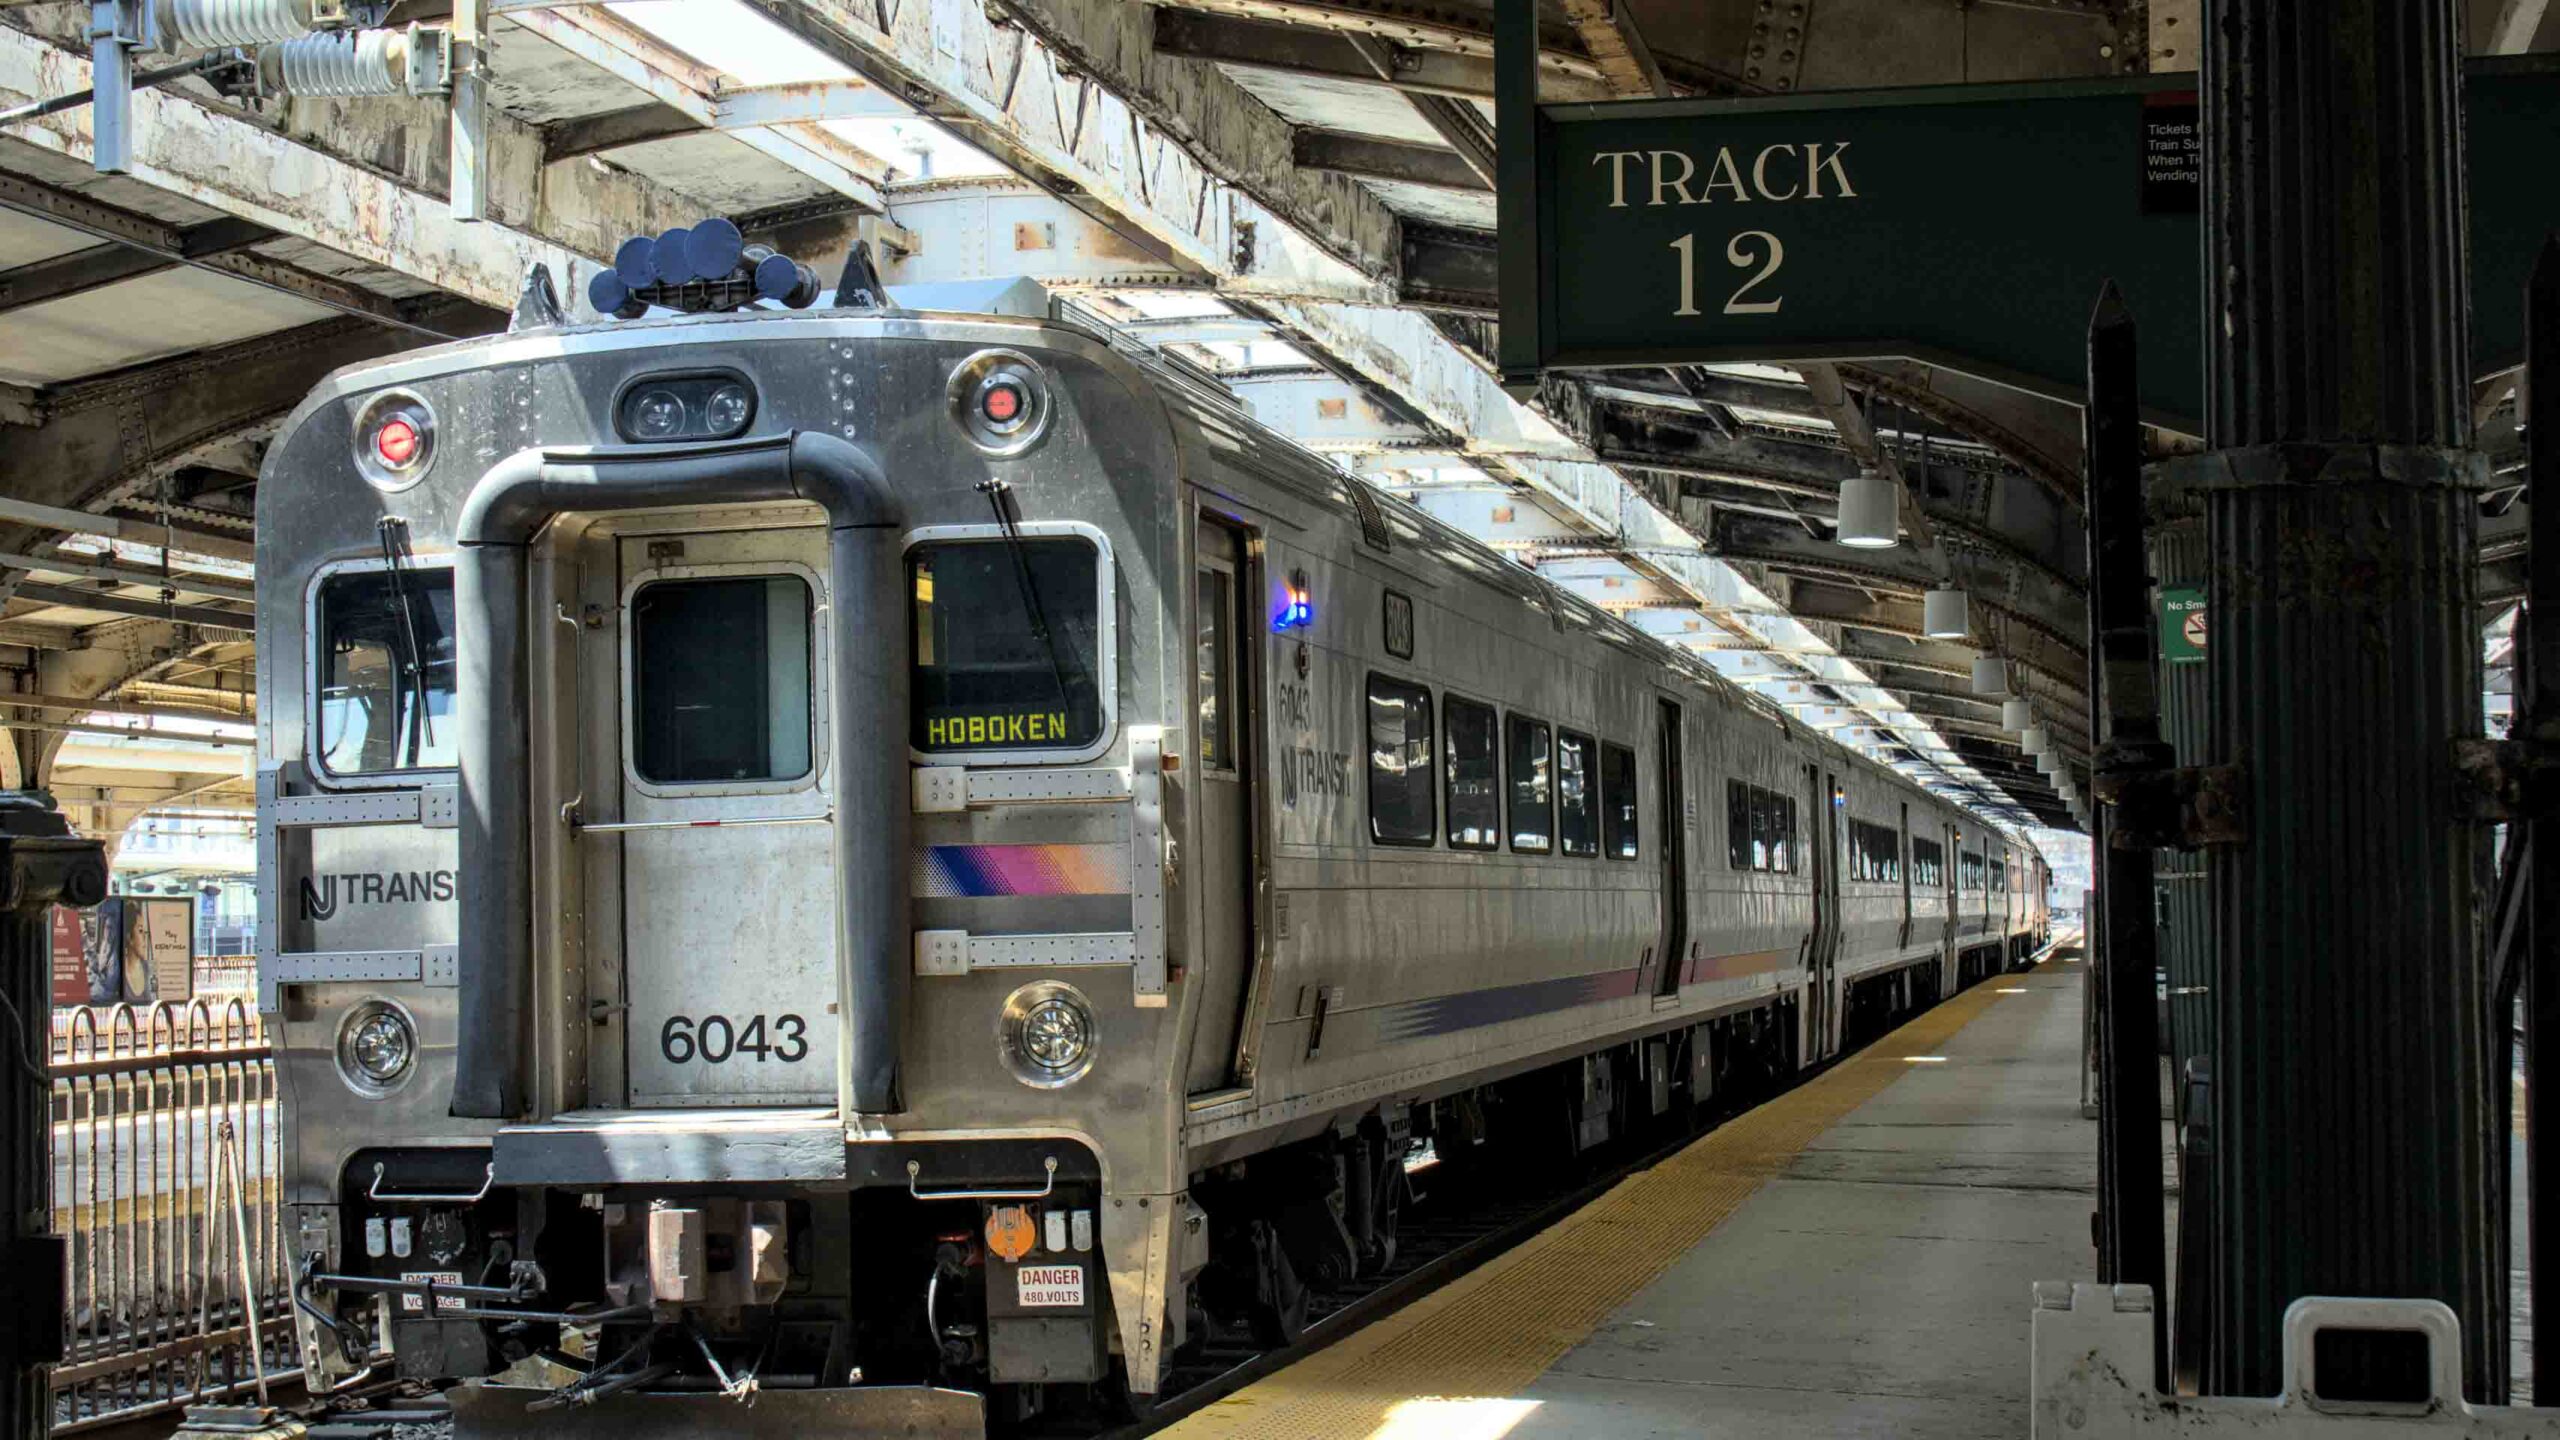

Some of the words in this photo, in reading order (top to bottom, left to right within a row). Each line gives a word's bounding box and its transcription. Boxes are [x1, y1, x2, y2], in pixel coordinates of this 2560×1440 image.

[2147, 123, 2192, 136] Tickets
[2147, 139, 2179, 151] Train
[2147, 154, 2184, 167] When
[1592, 141, 1858, 208] TRACK
[2147, 170, 2198, 183] Vending
[1668, 230, 1785, 317] 12
[2167, 601, 2183, 611] No
[1279, 682, 1310, 732] 6043
[928, 712, 1067, 745] HOBOKEN
[661, 1013, 809, 1064] 6043
[1021, 1269, 1079, 1285] DANGER
[407, 1296, 461, 1308] VOAGE
